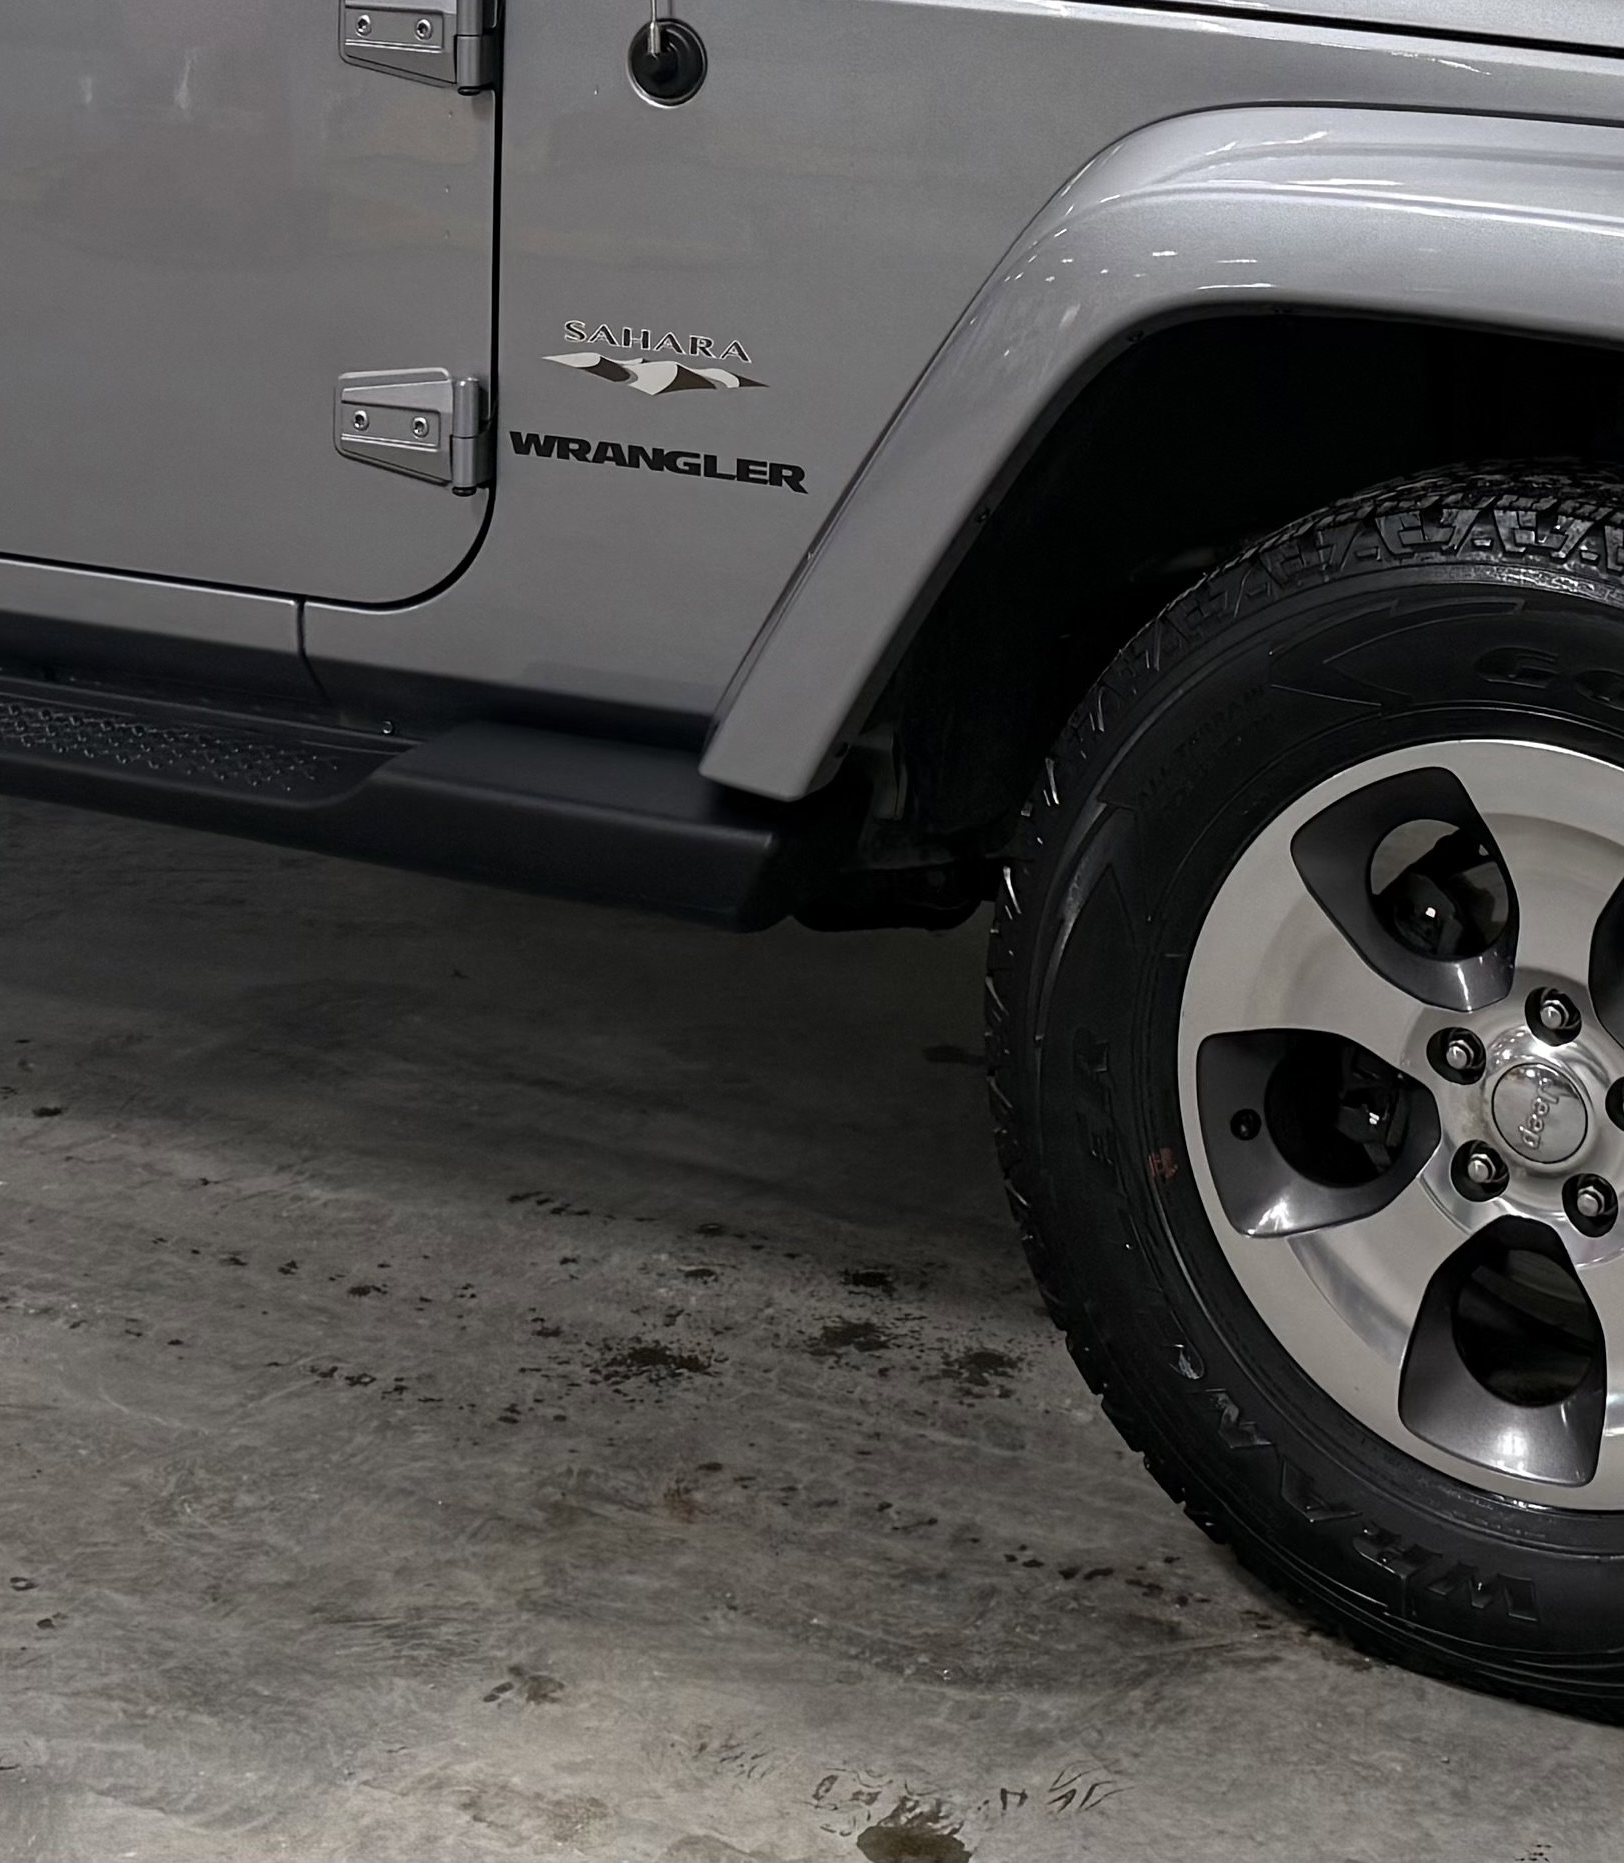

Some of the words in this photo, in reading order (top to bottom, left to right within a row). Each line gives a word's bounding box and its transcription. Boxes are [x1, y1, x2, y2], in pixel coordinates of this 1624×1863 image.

[563, 319, 753, 364] SAHARA
[509, 430, 809, 495] WRANGLER
[1518, 1077, 1560, 1150] Jeep
